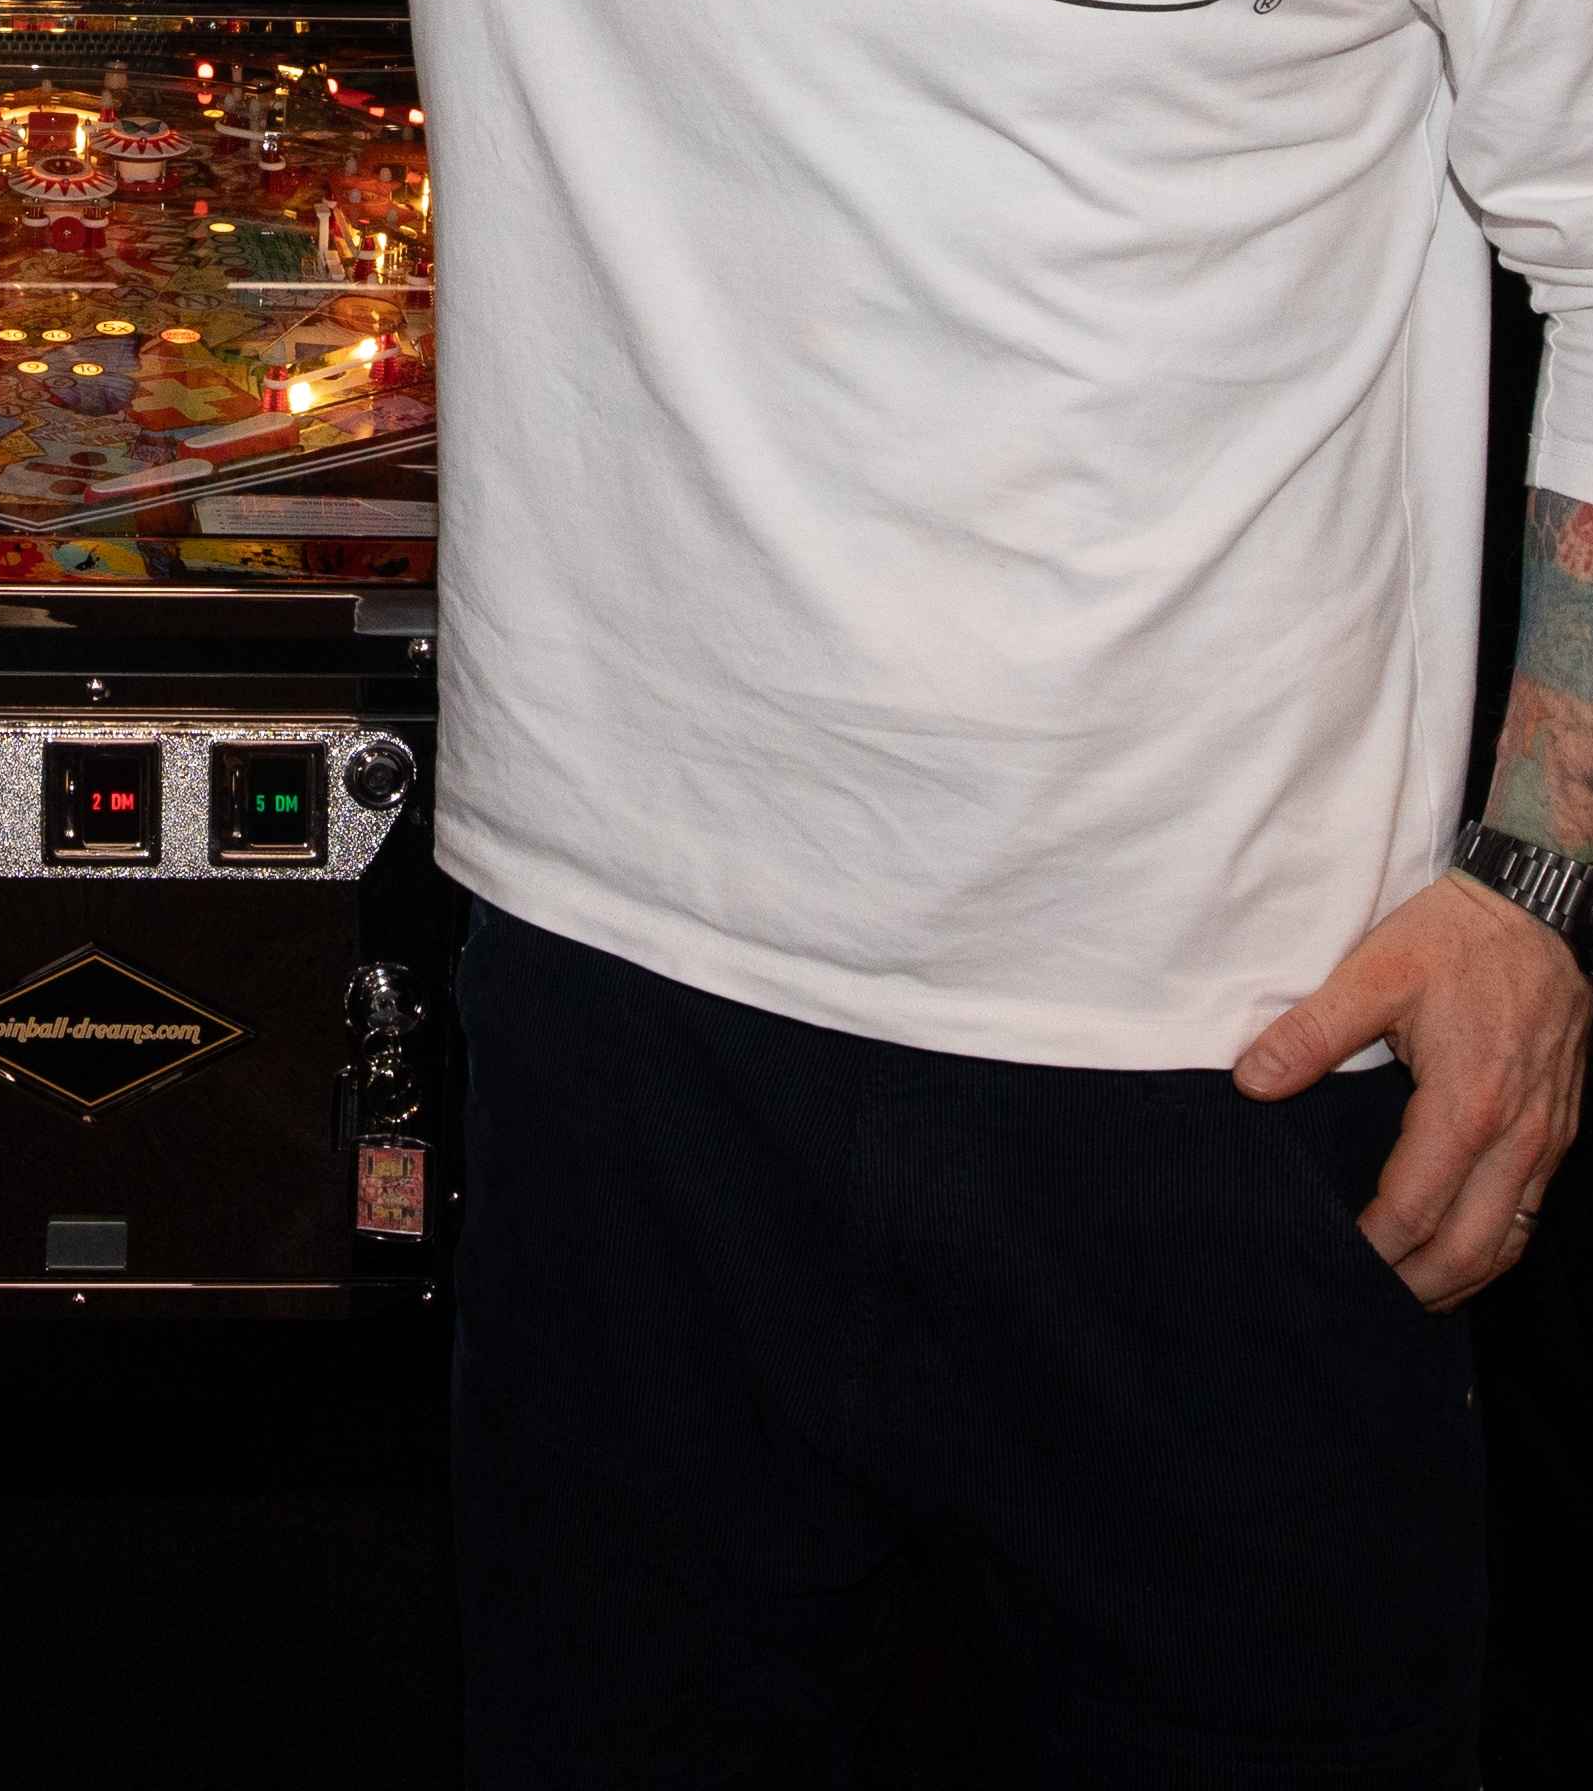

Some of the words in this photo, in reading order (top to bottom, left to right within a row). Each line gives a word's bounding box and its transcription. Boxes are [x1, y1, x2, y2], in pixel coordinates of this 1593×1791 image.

[92, 793, 102, 810] 2
[111, 793, 134, 810] DM
[256, 794, 265, 812] 5
[275, 794, 298, 813] DM
